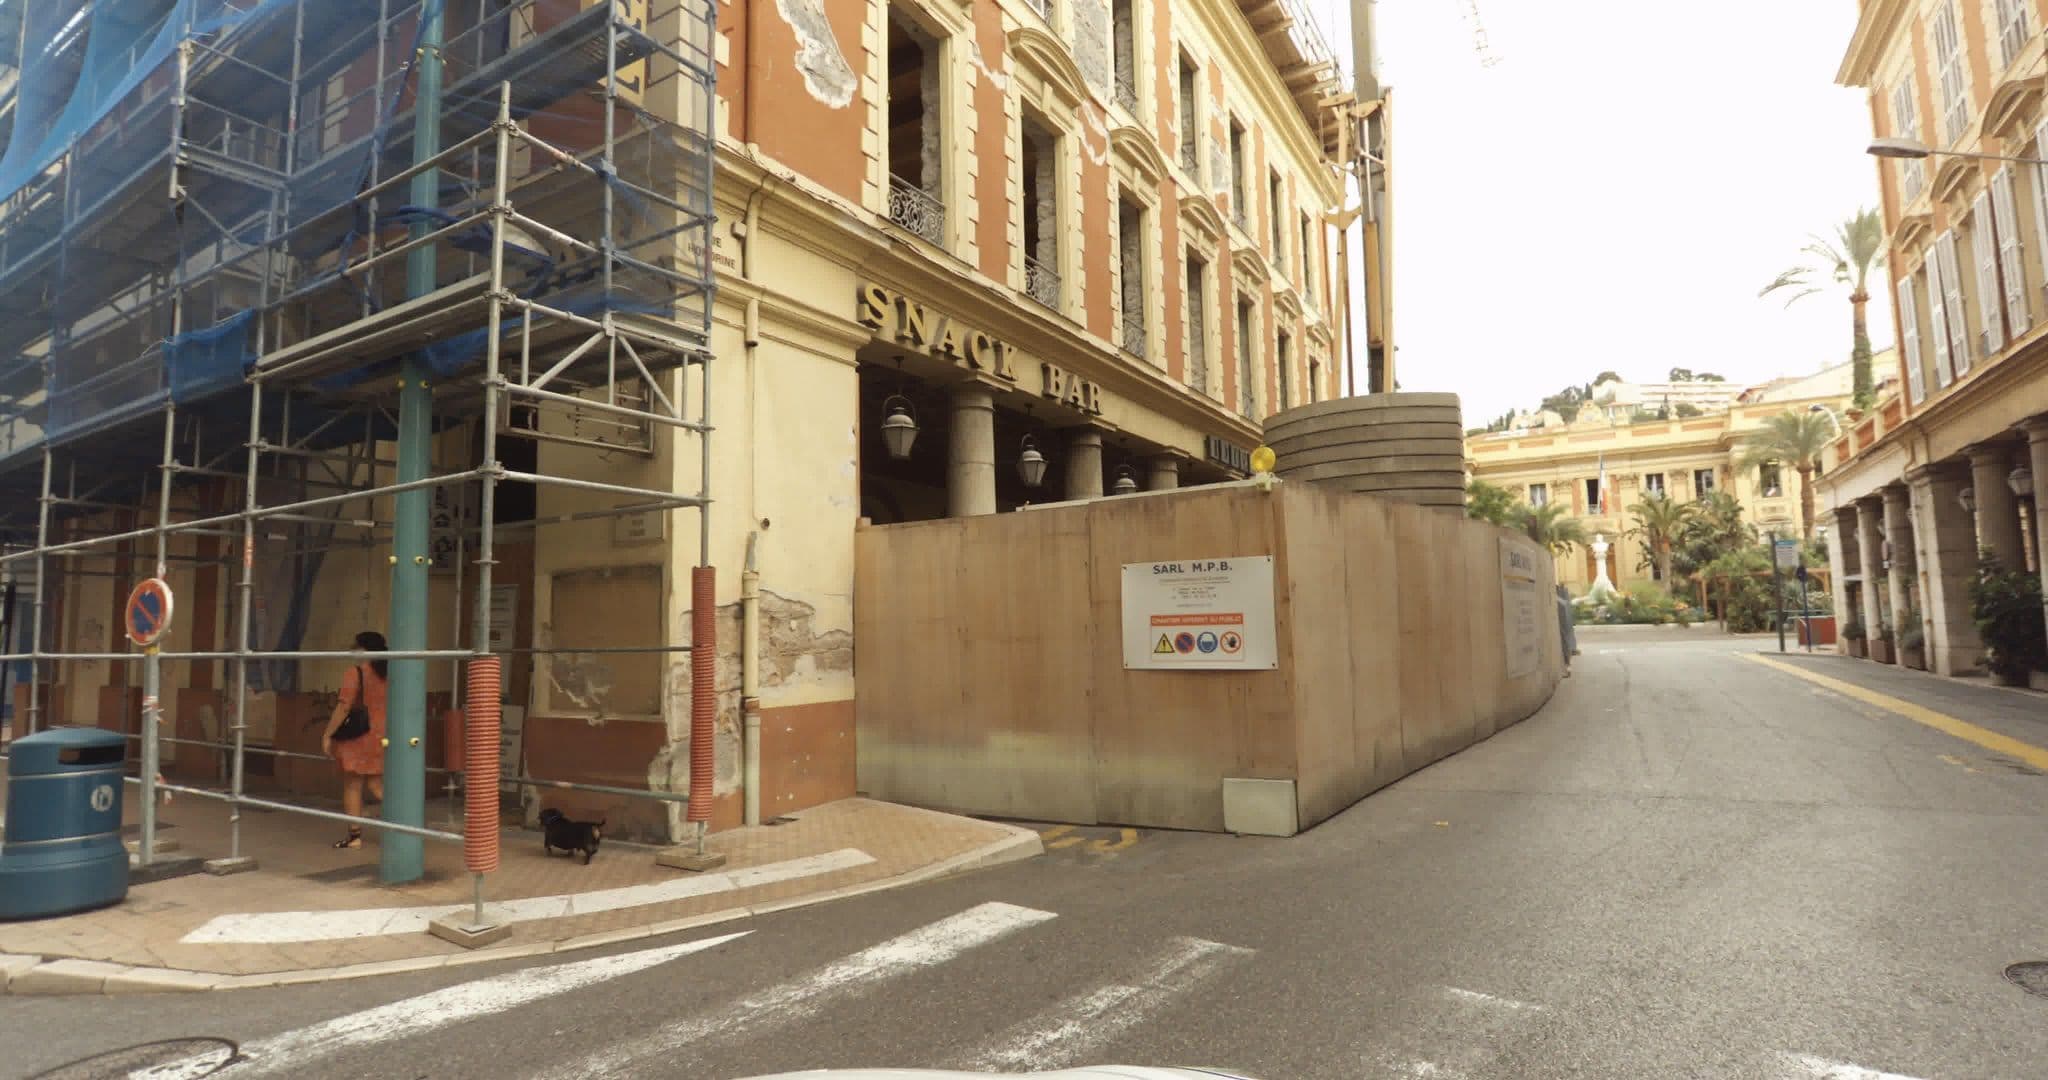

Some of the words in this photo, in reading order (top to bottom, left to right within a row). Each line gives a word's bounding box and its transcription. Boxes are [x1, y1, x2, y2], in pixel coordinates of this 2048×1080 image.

[857, 282, 1018, 382] SNACK
[1041, 362, 1102, 415] BAR
[1153, 564, 1184, 574] SARL
[1192, 561, 1232, 572] M.P.B.
